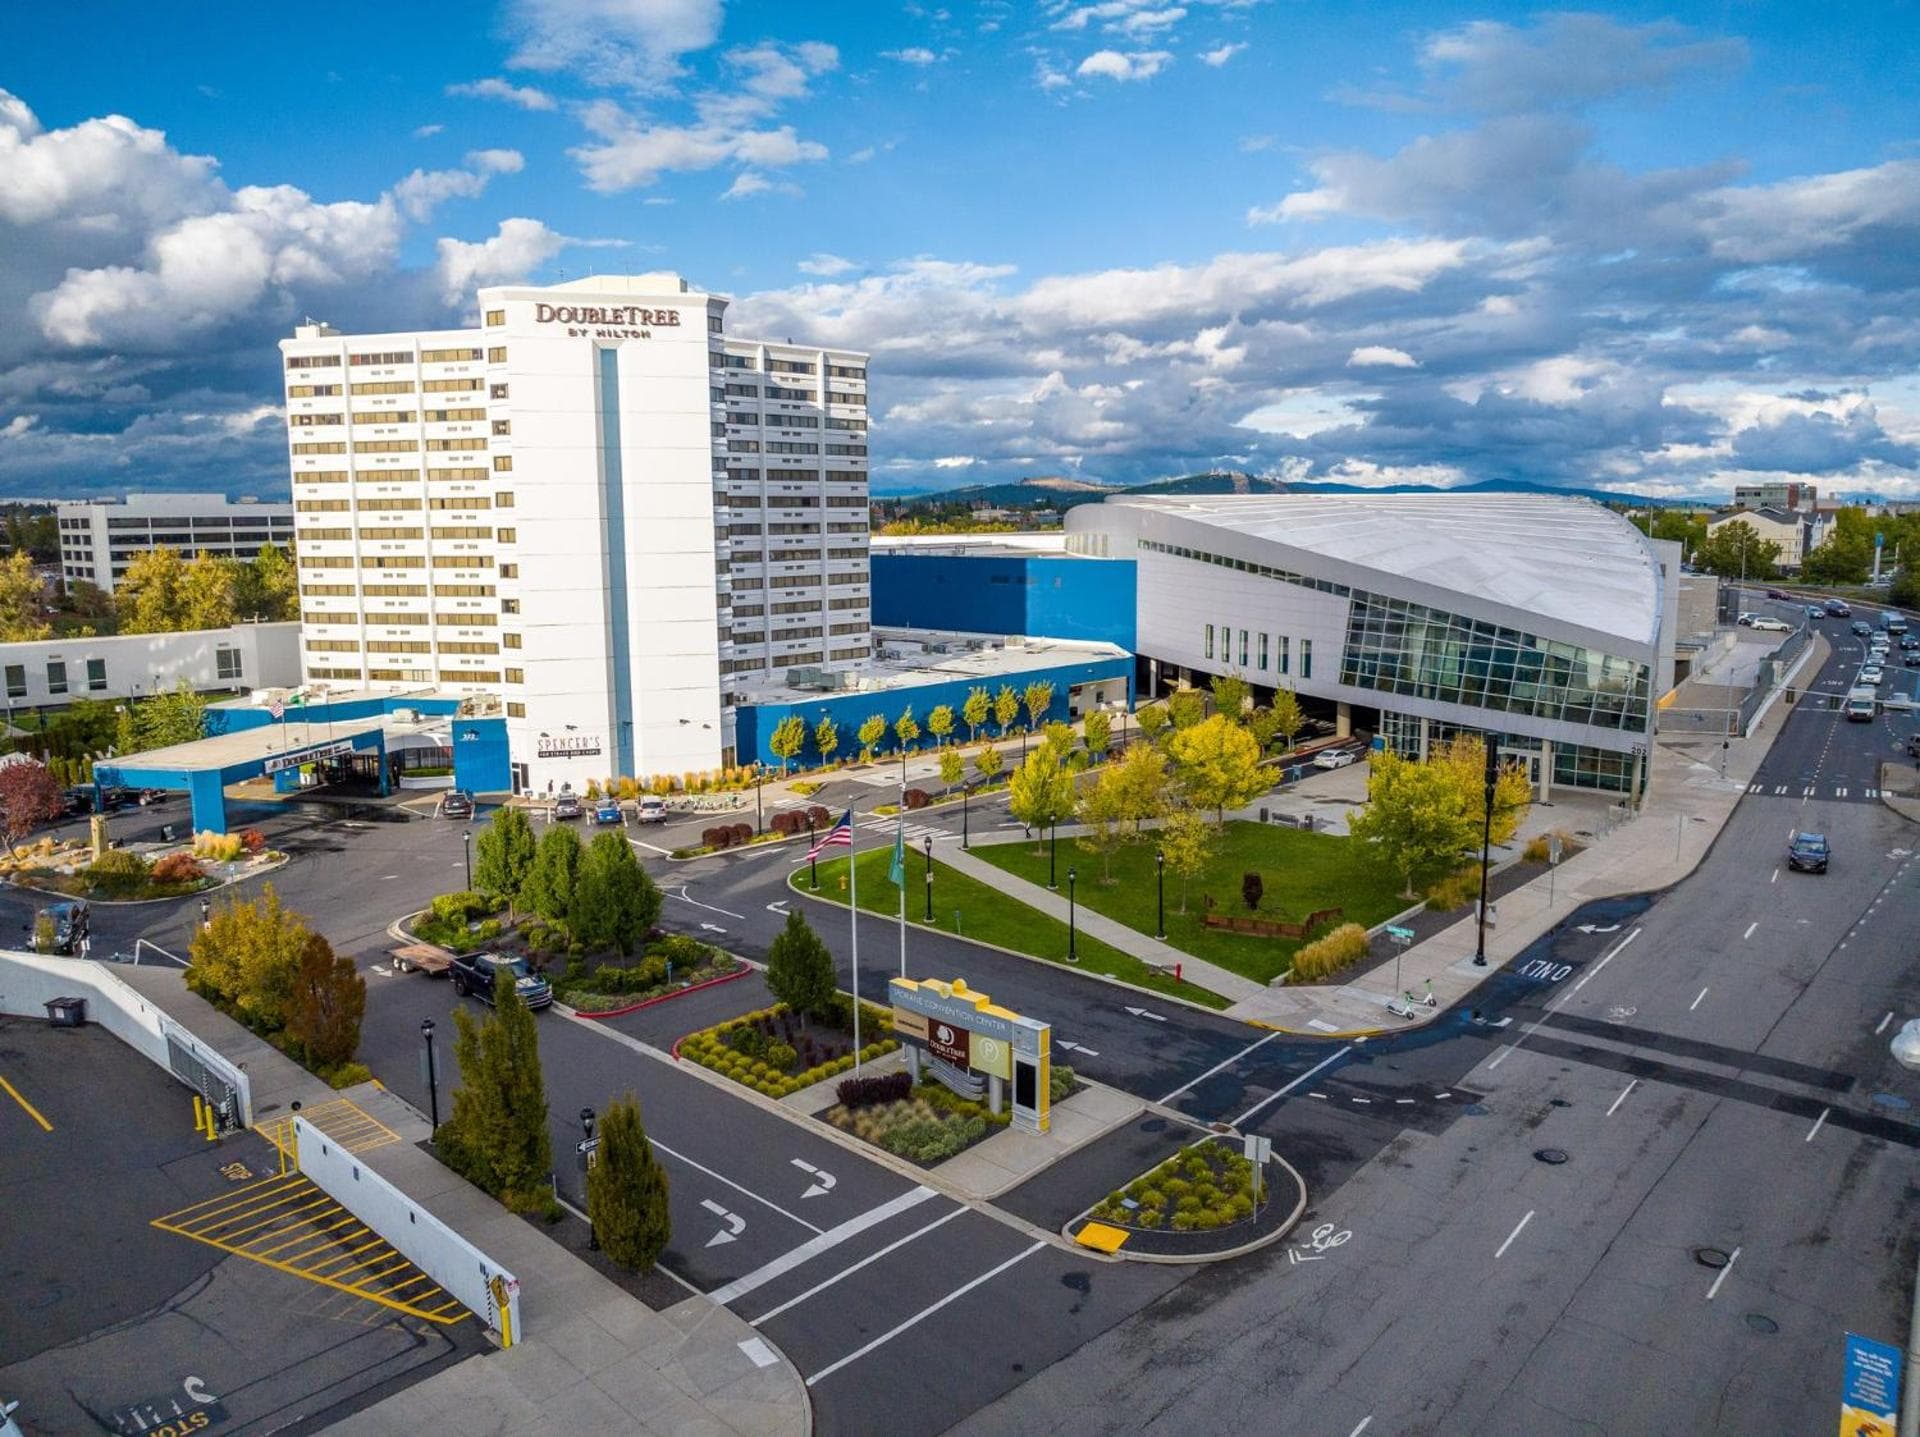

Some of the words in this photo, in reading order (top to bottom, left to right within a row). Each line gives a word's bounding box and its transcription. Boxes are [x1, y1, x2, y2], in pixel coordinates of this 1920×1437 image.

[535, 303, 681, 327] DOUBLETREE
[568, 328, 588, 337] BY
[596, 328, 652, 339] HILTON
[538, 736, 600, 751] SPENCER'S
[1518, 959, 1573, 981] ONLY
[149, 1411, 210, 1437] STO
